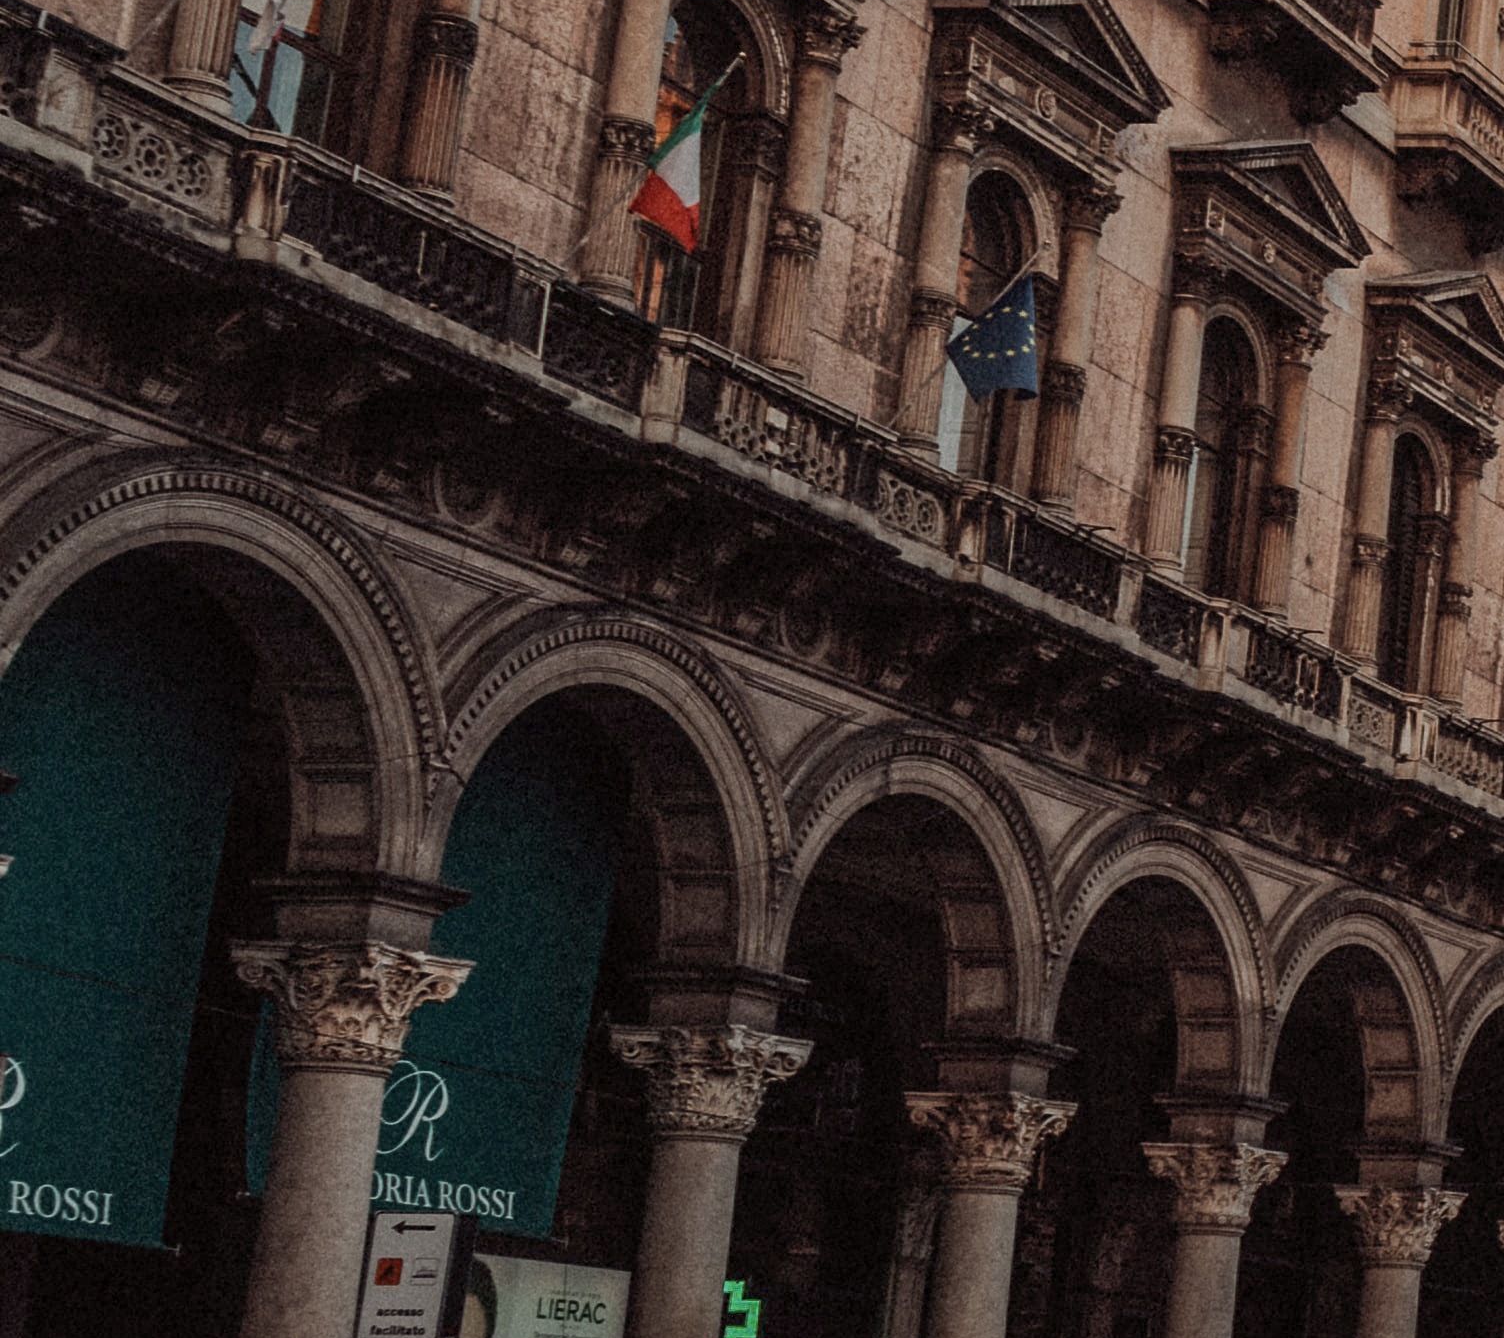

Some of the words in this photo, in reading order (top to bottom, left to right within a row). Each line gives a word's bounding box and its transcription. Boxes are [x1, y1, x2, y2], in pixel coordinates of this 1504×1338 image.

[9, 1180, 114, 1225] ROSSI
[438, 1180, 516, 1220] ROSSI
[376, 1308, 424, 1317] accesso
[536, 1297, 607, 1324] LIERAC
[370, 1324, 425, 1335] facilitato
